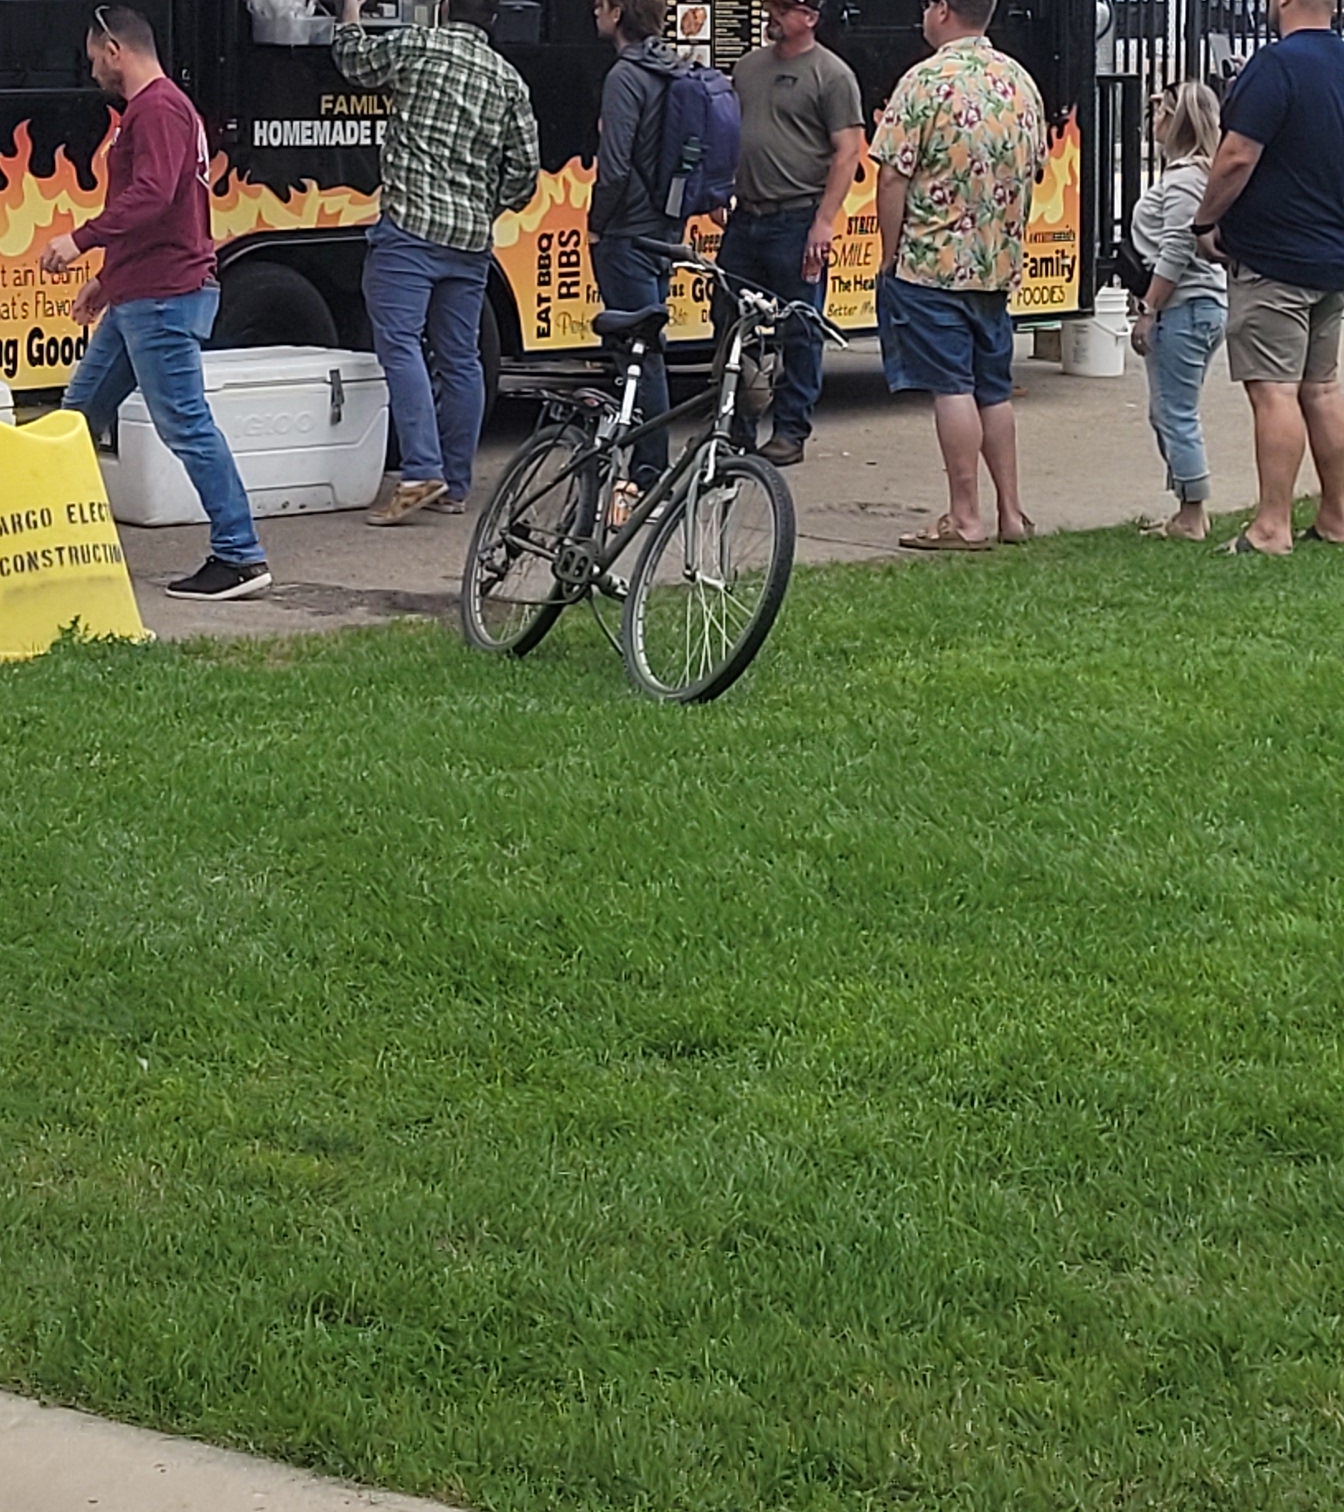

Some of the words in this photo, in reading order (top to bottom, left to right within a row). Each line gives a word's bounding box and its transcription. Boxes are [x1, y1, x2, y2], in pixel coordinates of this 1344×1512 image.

[320, 94, 393, 115] FAMILY
[253, 120, 372, 146] HOMEMADE
[536, 232, 554, 286] BBQ
[558, 229, 581, 300] RIBS
[830, 275, 851, 293] The
[536, 293, 551, 339] EAT
[25, 326, 89, 368] Good
